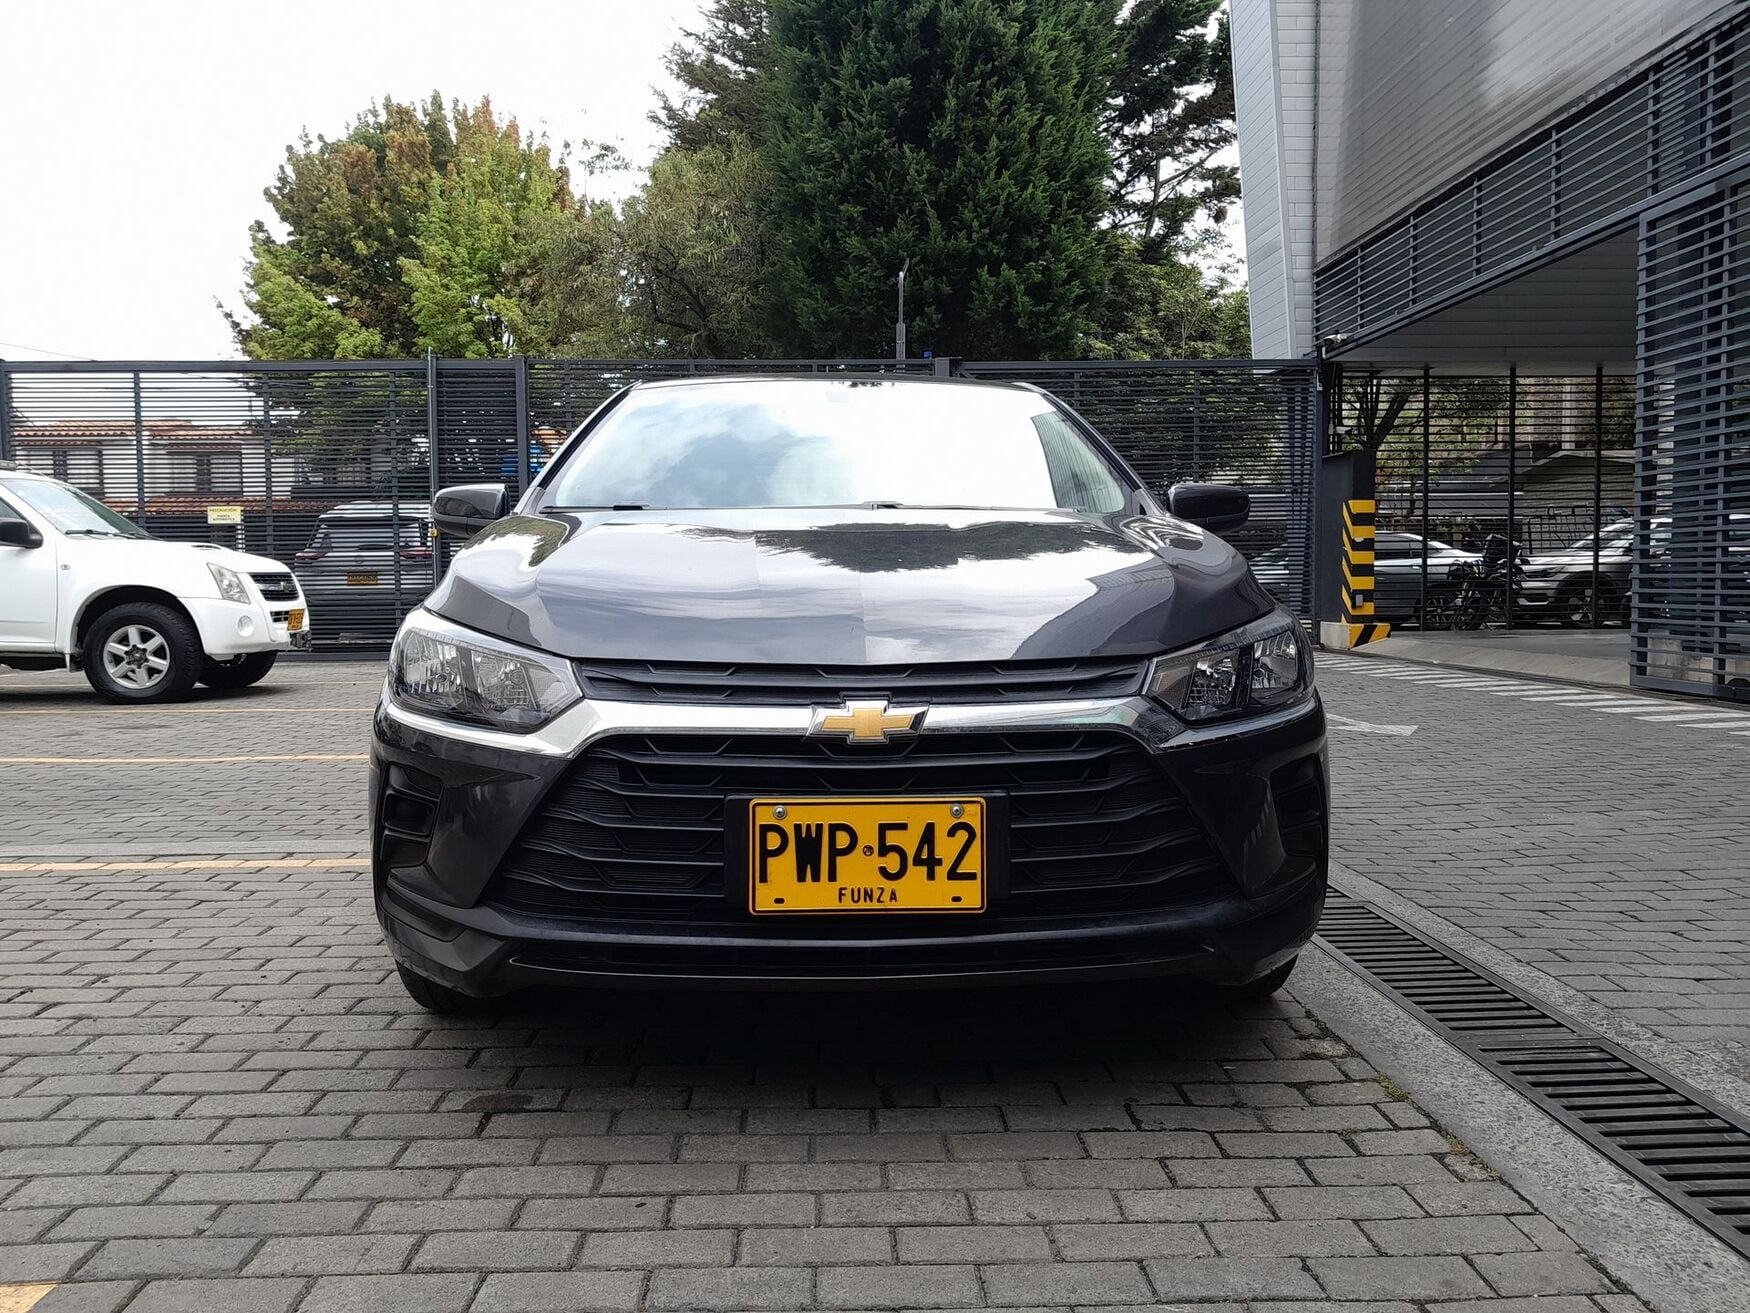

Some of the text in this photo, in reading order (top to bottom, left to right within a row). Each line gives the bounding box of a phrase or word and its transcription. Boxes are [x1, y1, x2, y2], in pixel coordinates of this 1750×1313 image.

[758, 821, 978, 883] PWP 542
[837, 887, 898, 904] FUNZA
